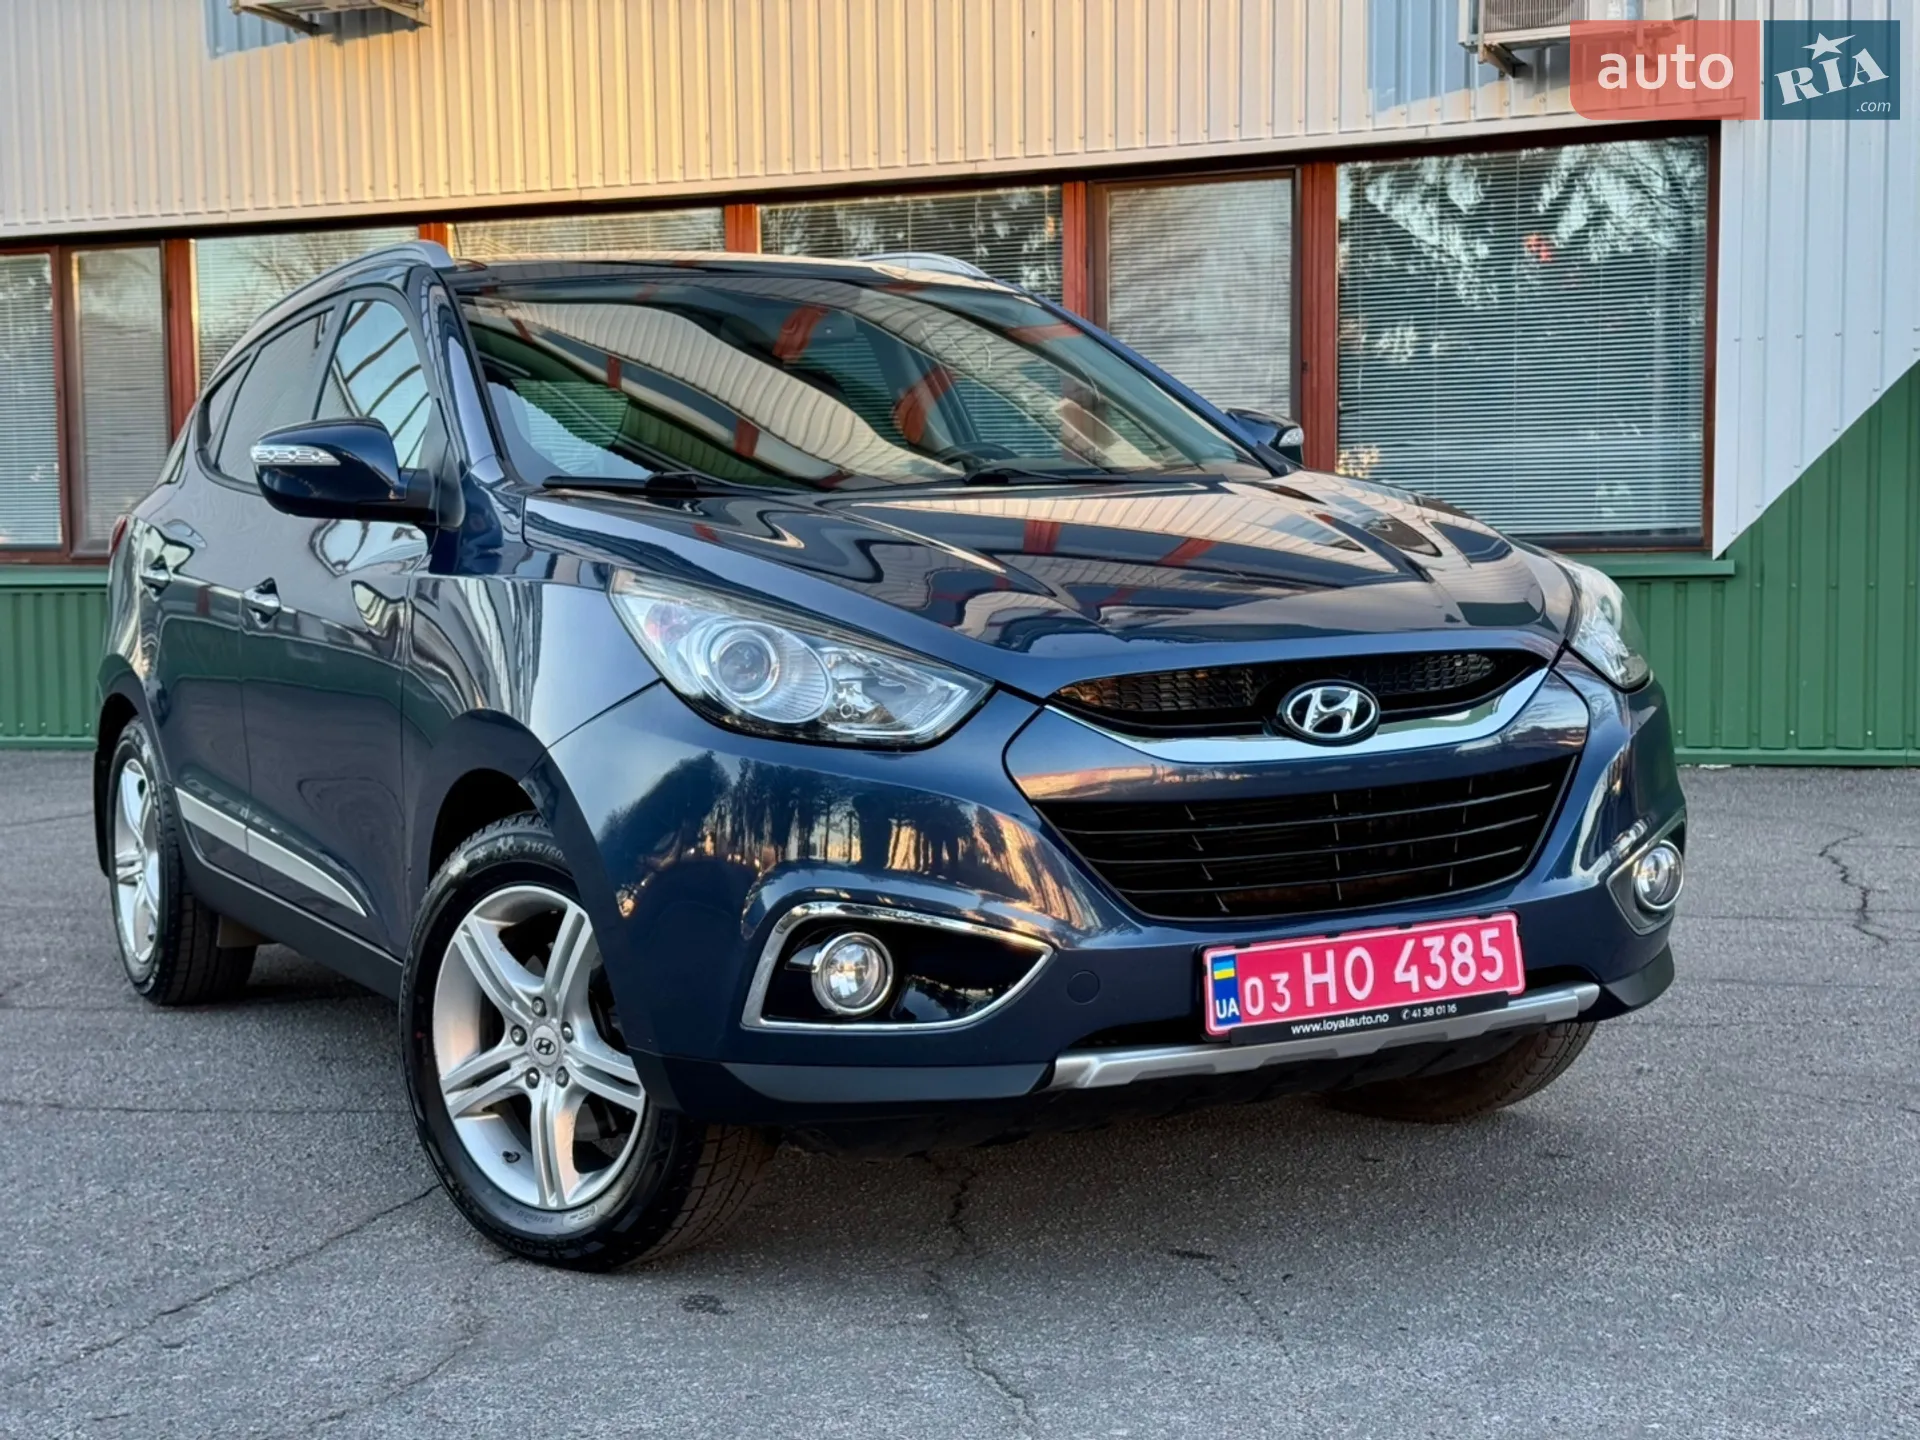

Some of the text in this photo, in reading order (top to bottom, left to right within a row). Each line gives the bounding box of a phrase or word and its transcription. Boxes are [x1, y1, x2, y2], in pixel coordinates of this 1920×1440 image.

[1244, 927, 1505, 1016] 03 HO 4385
[1215, 997, 1240, 1019] UA
[1290, 1012, 1390, 1035] www.loyalauto.no
[1411, 1009, 1421, 1018] 41
[1423, 1007, 1435, 1017] 38
[1447, 1003, 1457, 1014] 16
